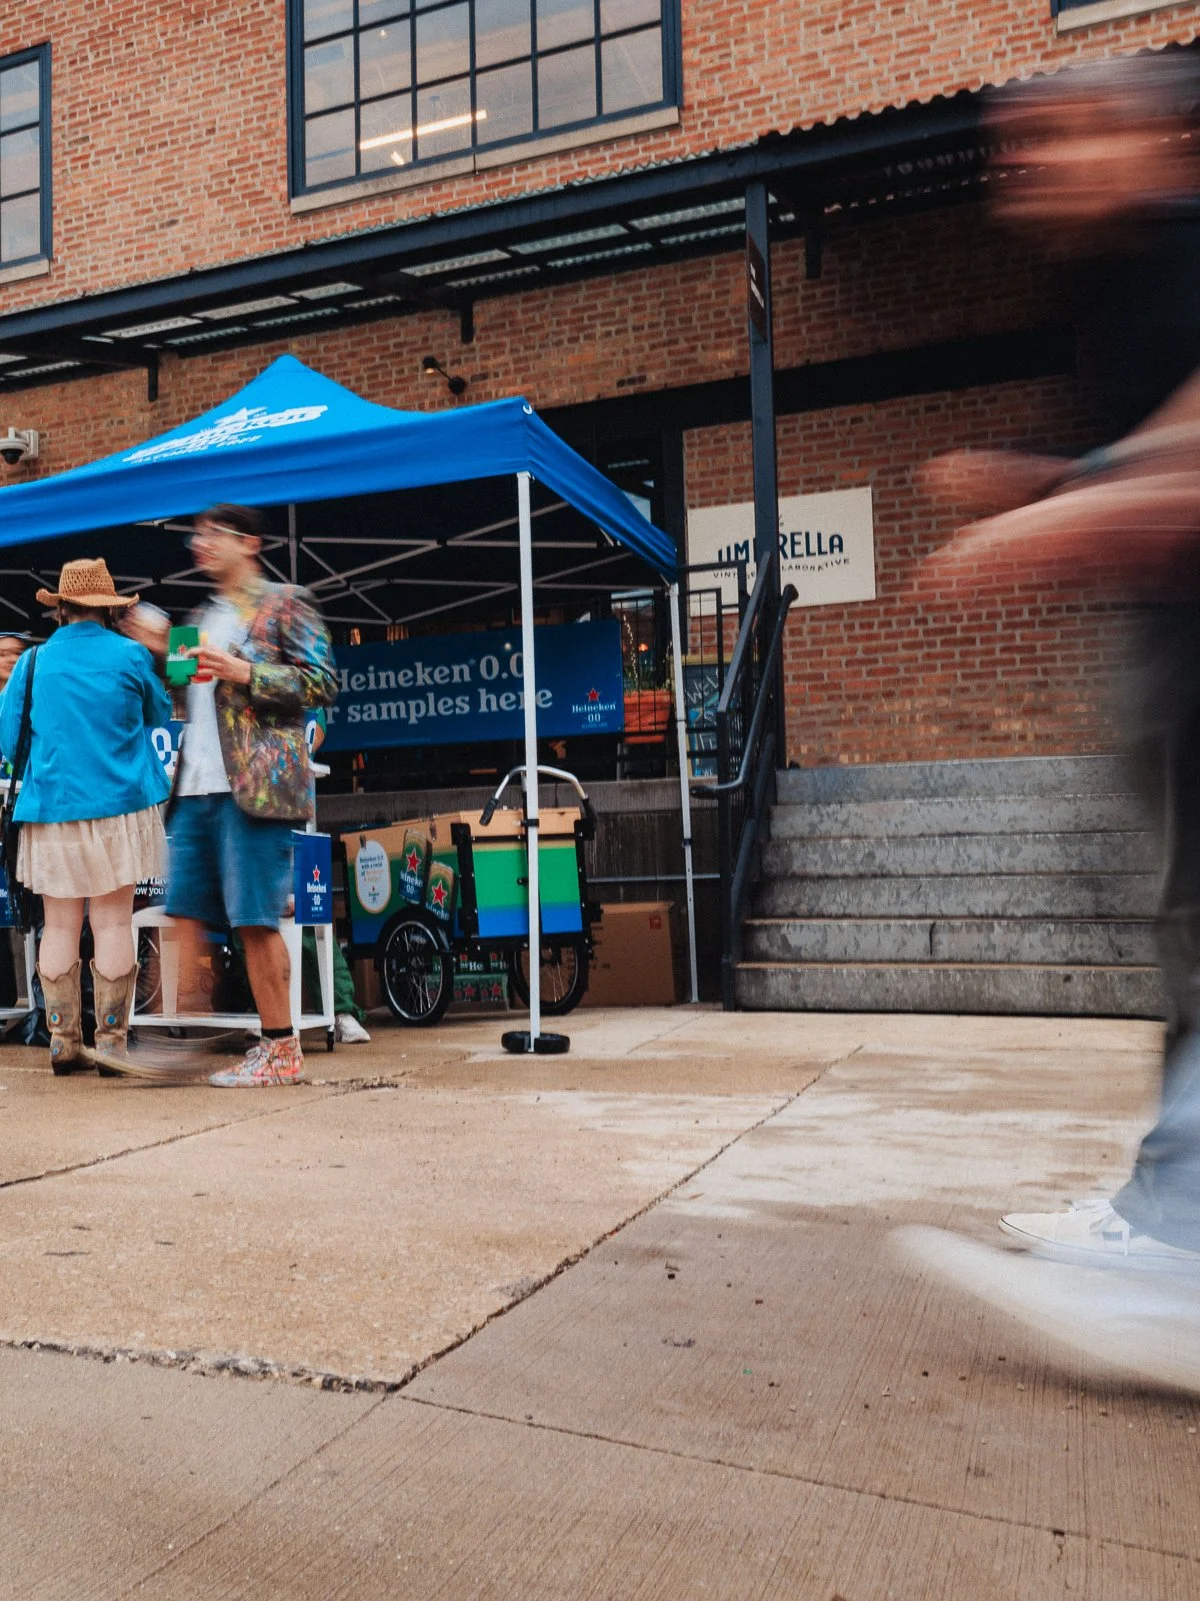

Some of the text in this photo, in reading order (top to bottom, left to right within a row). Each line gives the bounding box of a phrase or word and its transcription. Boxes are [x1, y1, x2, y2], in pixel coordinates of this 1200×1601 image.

[717, 530, 844, 563] UMRELLA
[781, 558, 850, 573] LABORATIVE
[336, 661, 471, 693] Heineken
[347, 691, 471, 725] samples
[135, 886, 148, 895] ow
